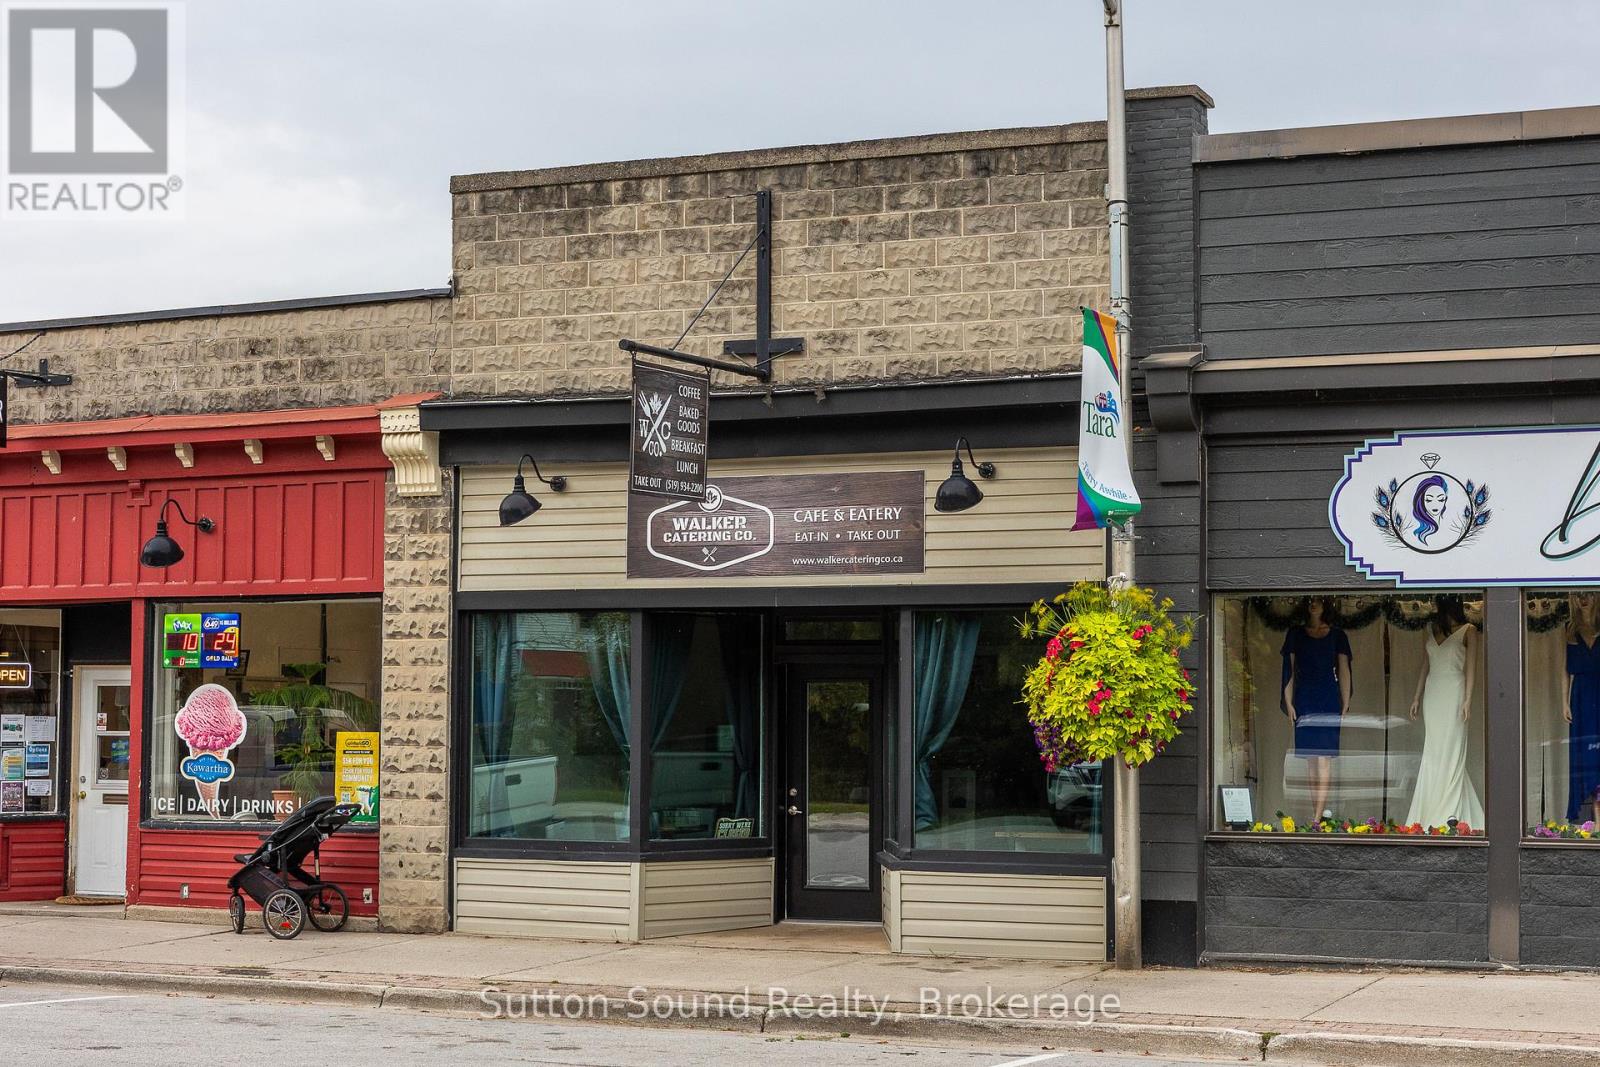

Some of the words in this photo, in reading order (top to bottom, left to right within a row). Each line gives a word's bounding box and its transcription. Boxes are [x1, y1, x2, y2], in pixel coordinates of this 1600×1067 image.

[678, 385, 701, 400] COFFEE
[679, 405, 699, 419] BAKED
[677, 420, 700, 434] GOODS
[1083, 402, 1116, 438] Tara
[638, 419, 649, 437] W
[661, 421, 671, 440] C
[648, 440, 662, 457] CO.
[671, 439, 705, 455] BREAKFAST
[676, 461, 698, 474] LUNCH
[634, 475, 648, 487] TAKE
[649, 477, 661, 488] OUT
[665, 479, 679, 492] (519)
[1099, 482, 1127, 500] Awhile
[793, 509, 829, 522] CAFE
[834, 508, 845, 521] &
[849, 507, 902, 521] EATERY
[672, 516, 747, 531] WALKER
[663, 531, 731, 543] CATERING
[734, 530, 757, 541] CO.
[795, 531, 829, 542] EAT-IN
[847, 530, 874, 540] TAKE
[877, 529, 901, 540] OUT
[792, 555, 903, 565] www.walkercateringco.ca
[173, 620, 192, 632] MAX
[183, 633, 199, 650] 10
[214, 633, 236, 650] 24
[0, 669, 26, 681] PEN
[187, 763, 228, 774] Kawartha
[153, 797, 176, 811] ICE
[187, 798, 230, 812] DAIRY
[241, 799, 294, 814] DRINKS
